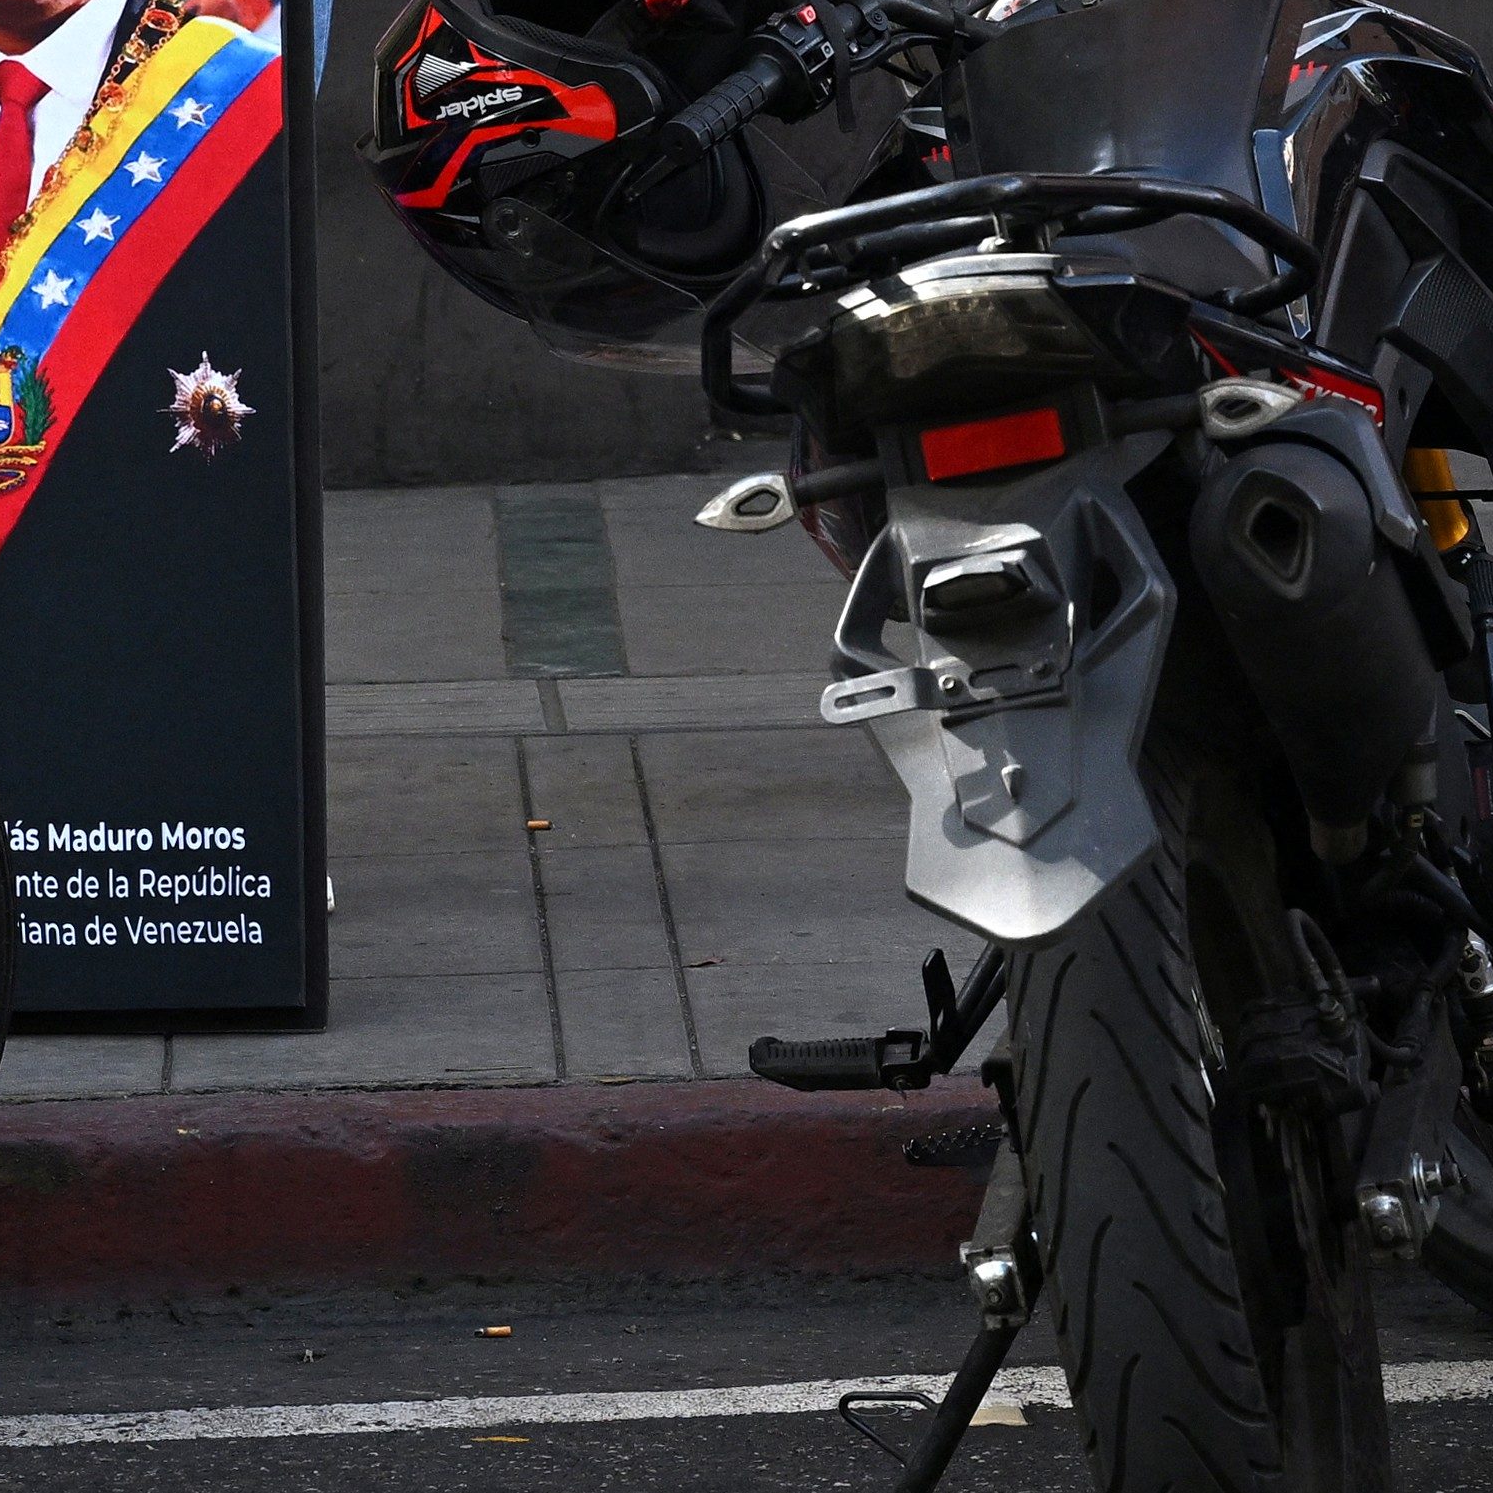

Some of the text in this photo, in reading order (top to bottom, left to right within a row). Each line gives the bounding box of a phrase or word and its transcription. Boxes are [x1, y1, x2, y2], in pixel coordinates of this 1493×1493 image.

[435, 85, 523, 121] spider
[48, 821, 153, 852] Maduro
[161, 821, 246, 851] Moros
[66, 868, 100, 899] de
[109, 868, 130, 899] la
[139, 865, 271, 905] República
[84, 915, 118, 946] de
[124, 913, 263, 946] Venezuela
